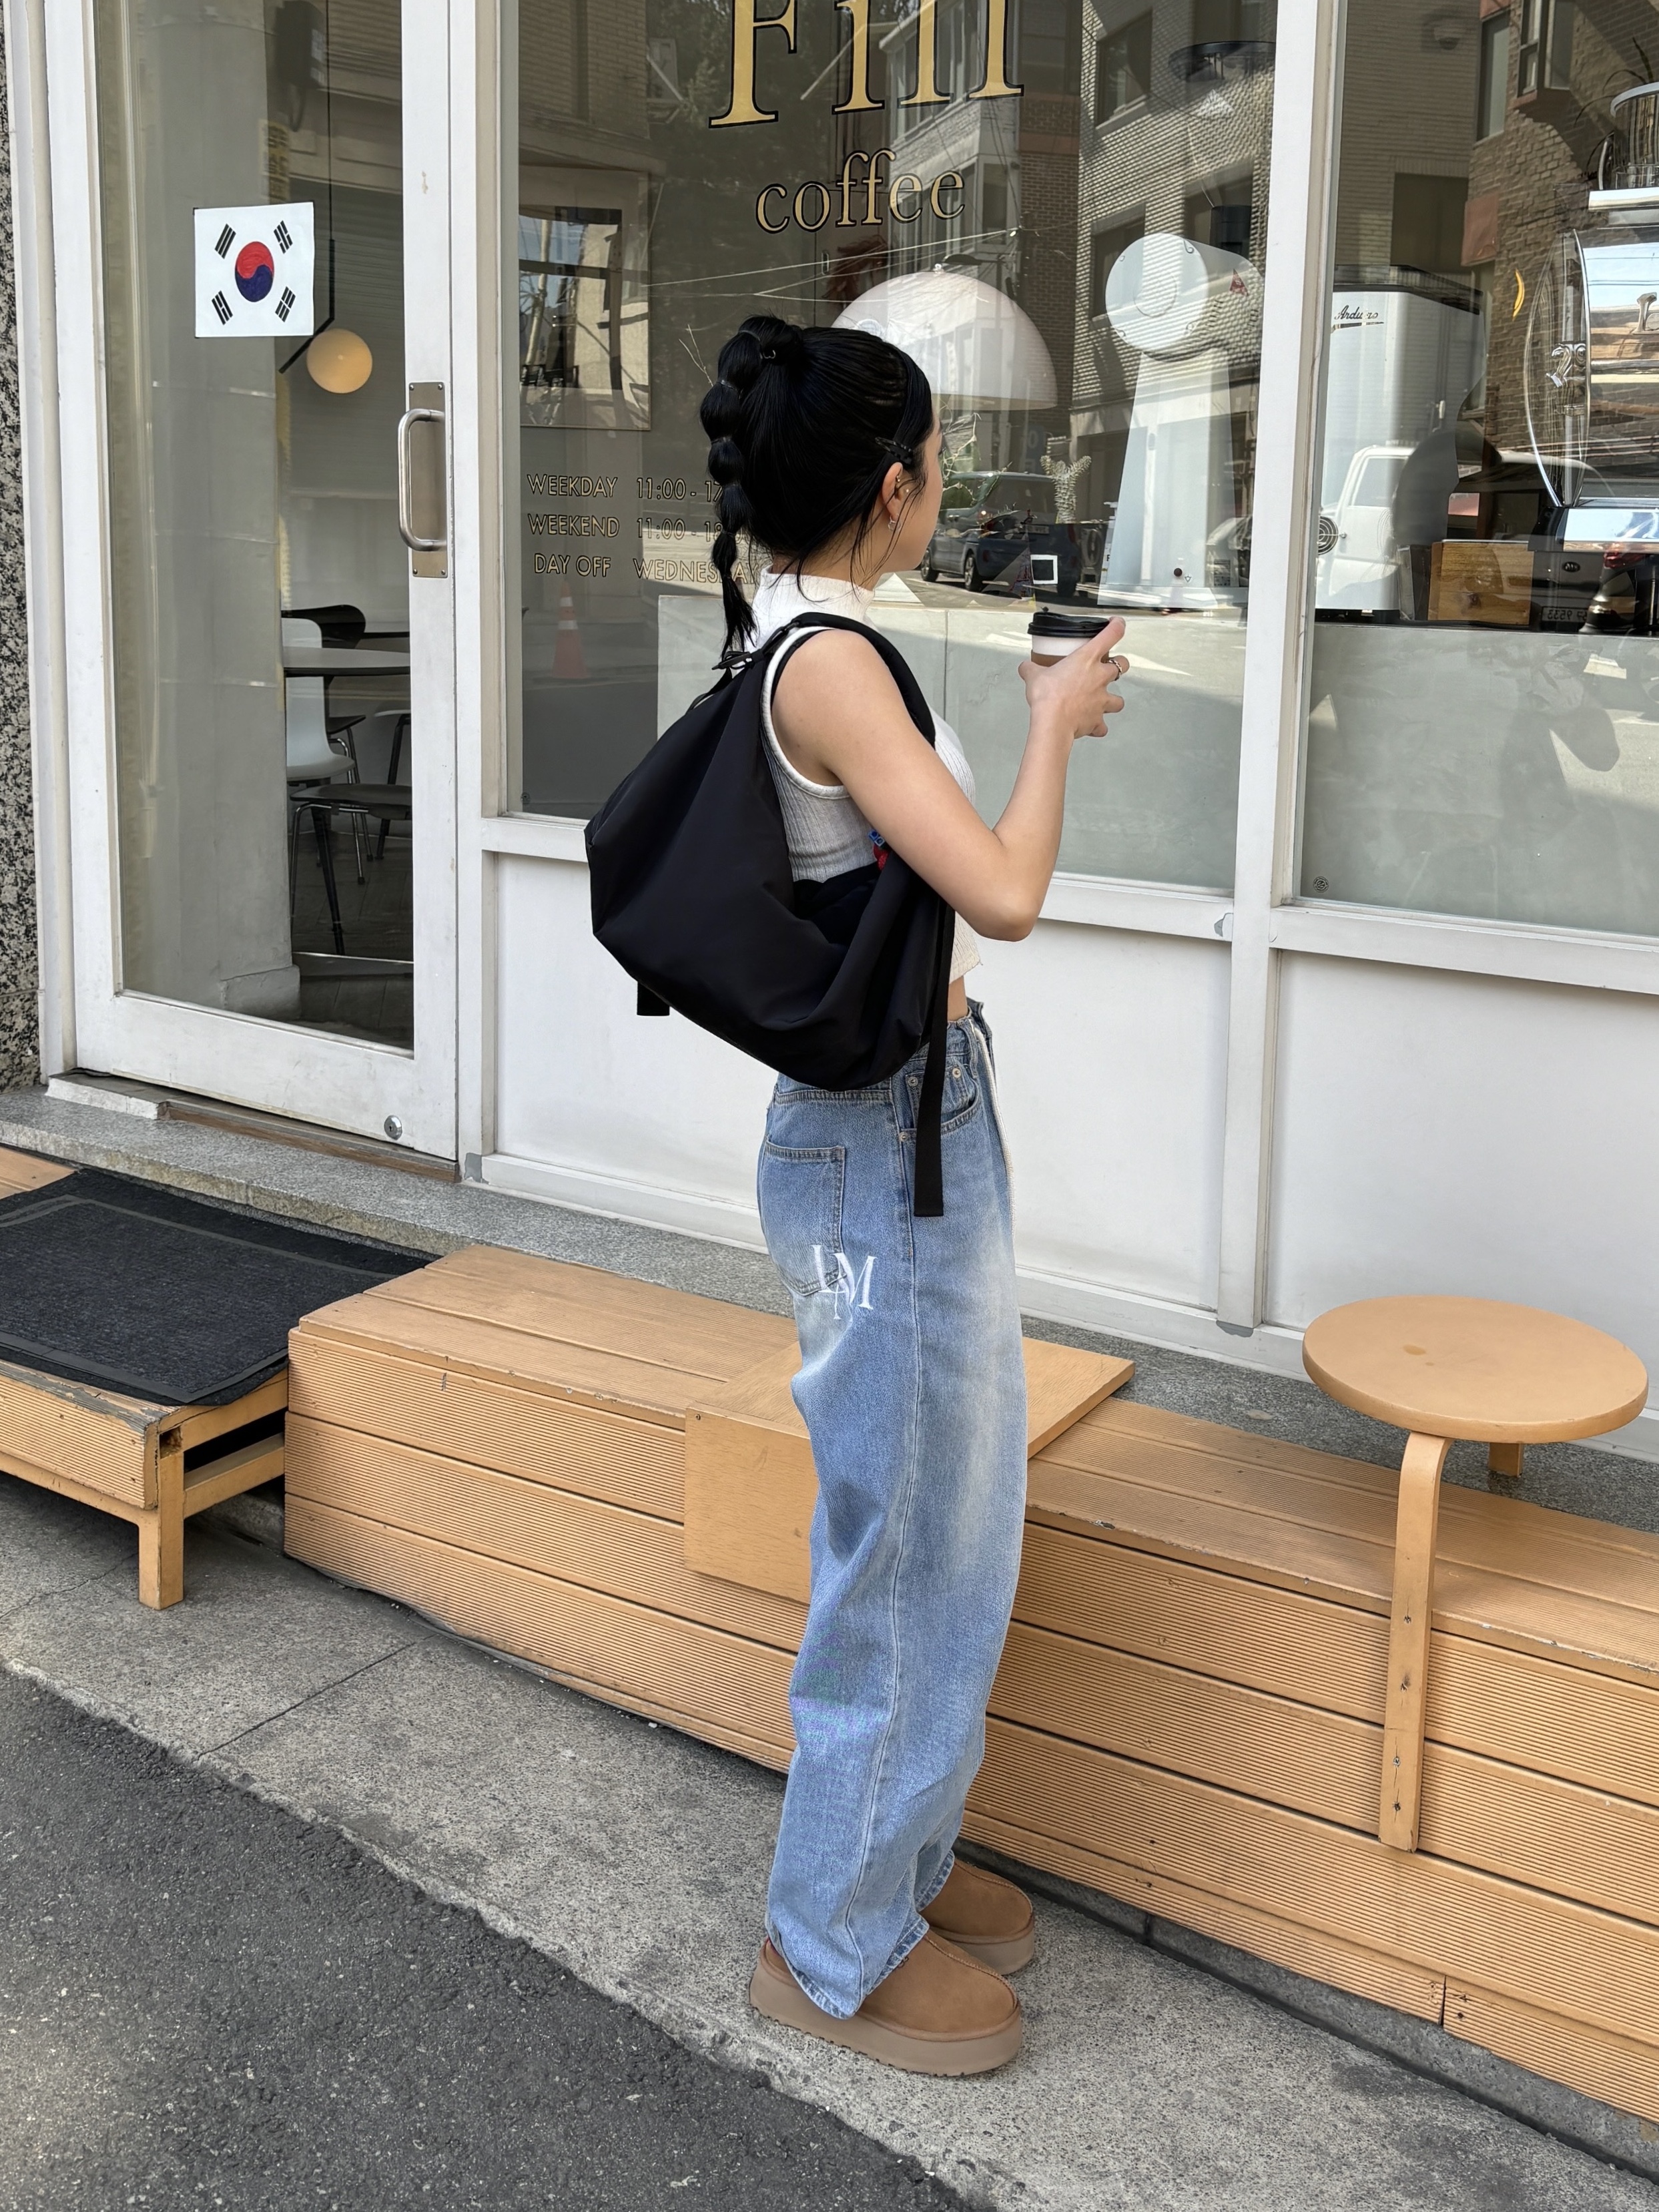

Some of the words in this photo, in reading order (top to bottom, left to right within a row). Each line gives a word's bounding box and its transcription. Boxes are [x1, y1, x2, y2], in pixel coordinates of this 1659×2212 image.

[755, 148, 965, 233] coffee
[527, 474, 618, 498] WEEKDAY
[637, 477, 686, 500] 11:00
[527, 513, 620, 537] WEEKEND
[637, 517, 686, 540] 11:00
[534, 553, 571, 574] DAY
[576, 555, 611, 577] OFF
[633, 557, 758, 585] WEDNESAY
